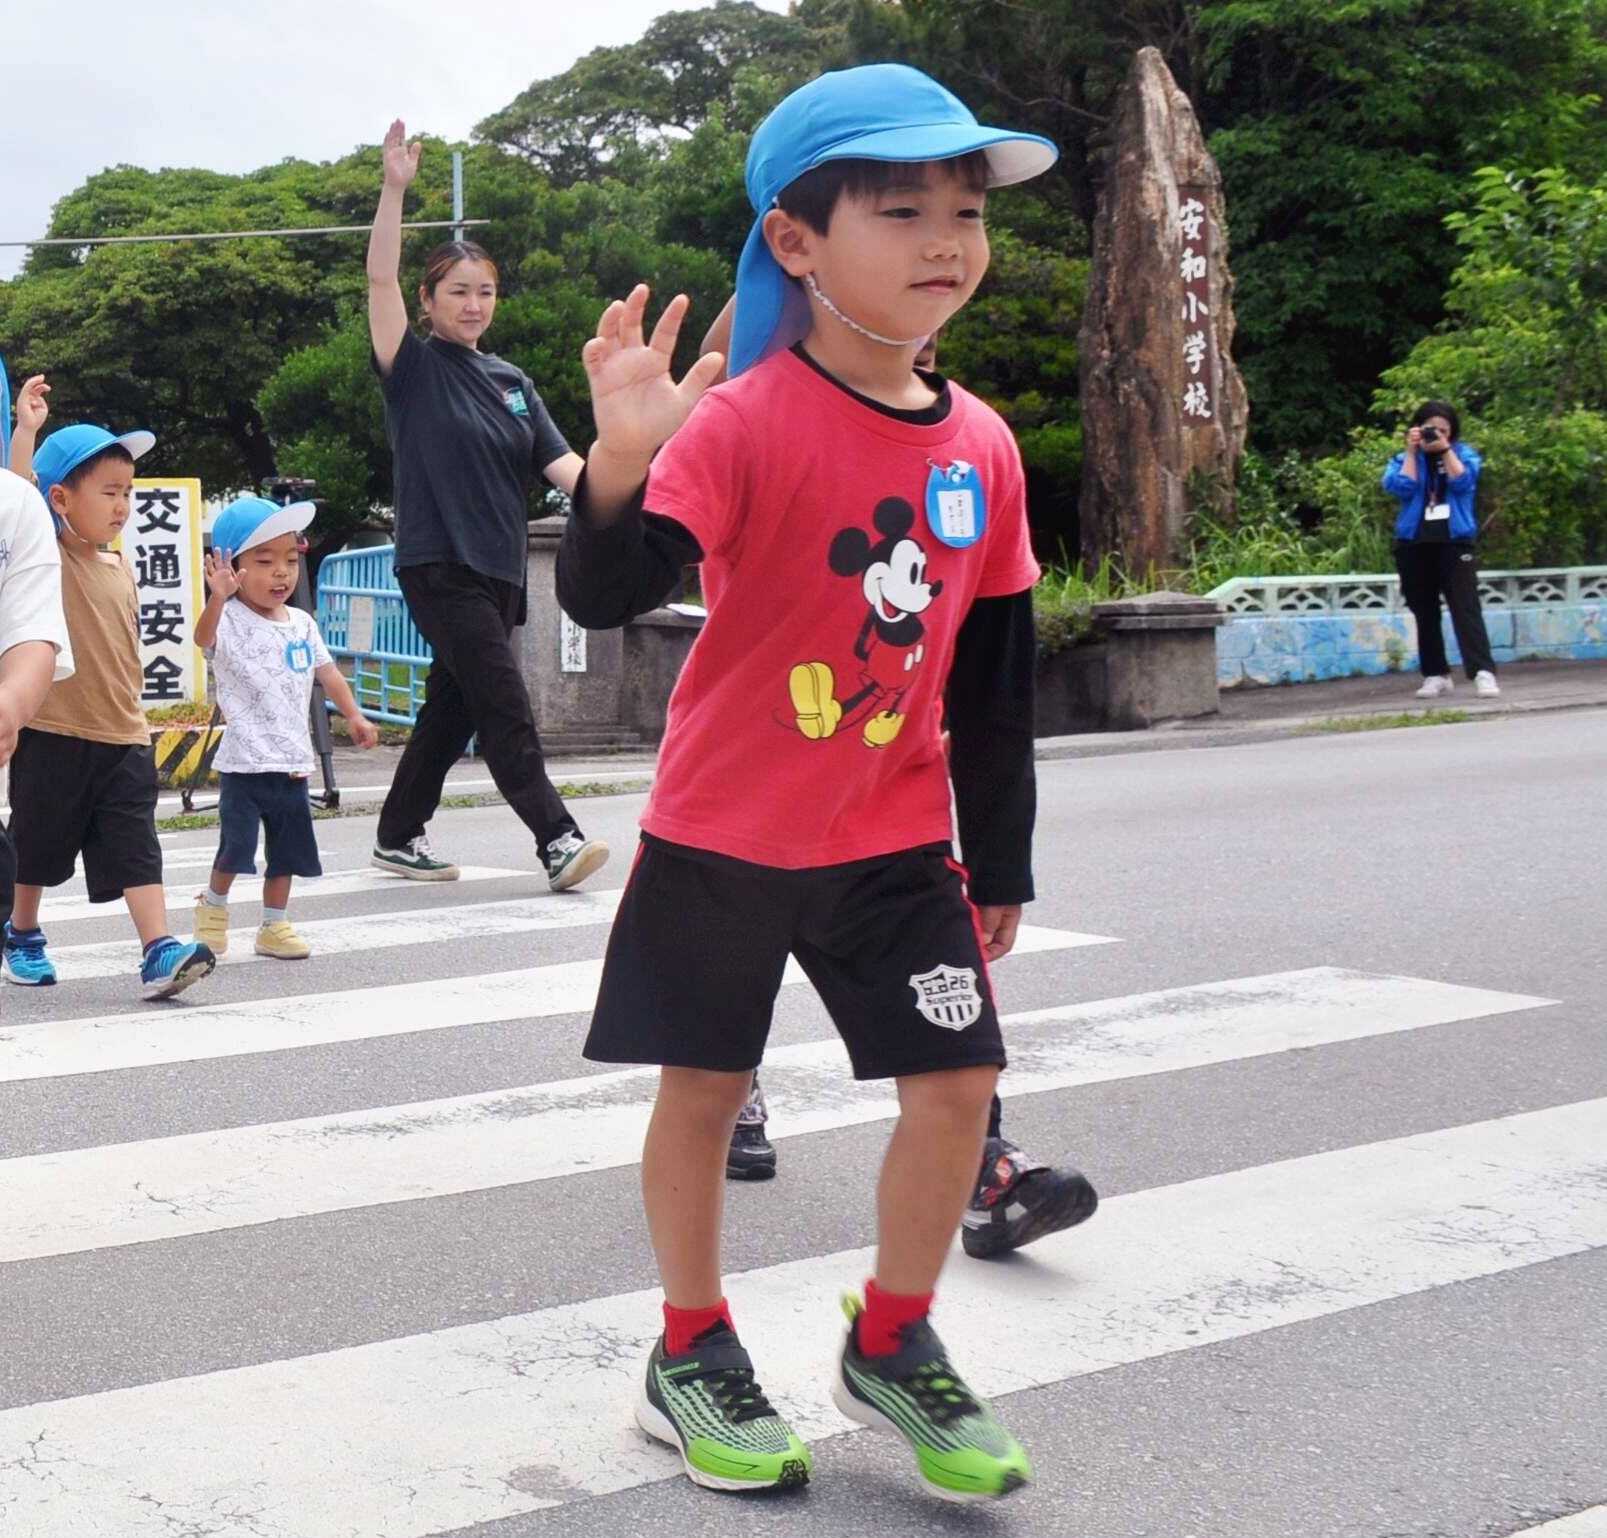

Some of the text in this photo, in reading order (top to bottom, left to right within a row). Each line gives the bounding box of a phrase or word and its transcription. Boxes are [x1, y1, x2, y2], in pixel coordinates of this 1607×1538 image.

[1176, 198, 1213, 418] 安和小学校
[135, 488, 185, 700] 交通安全
